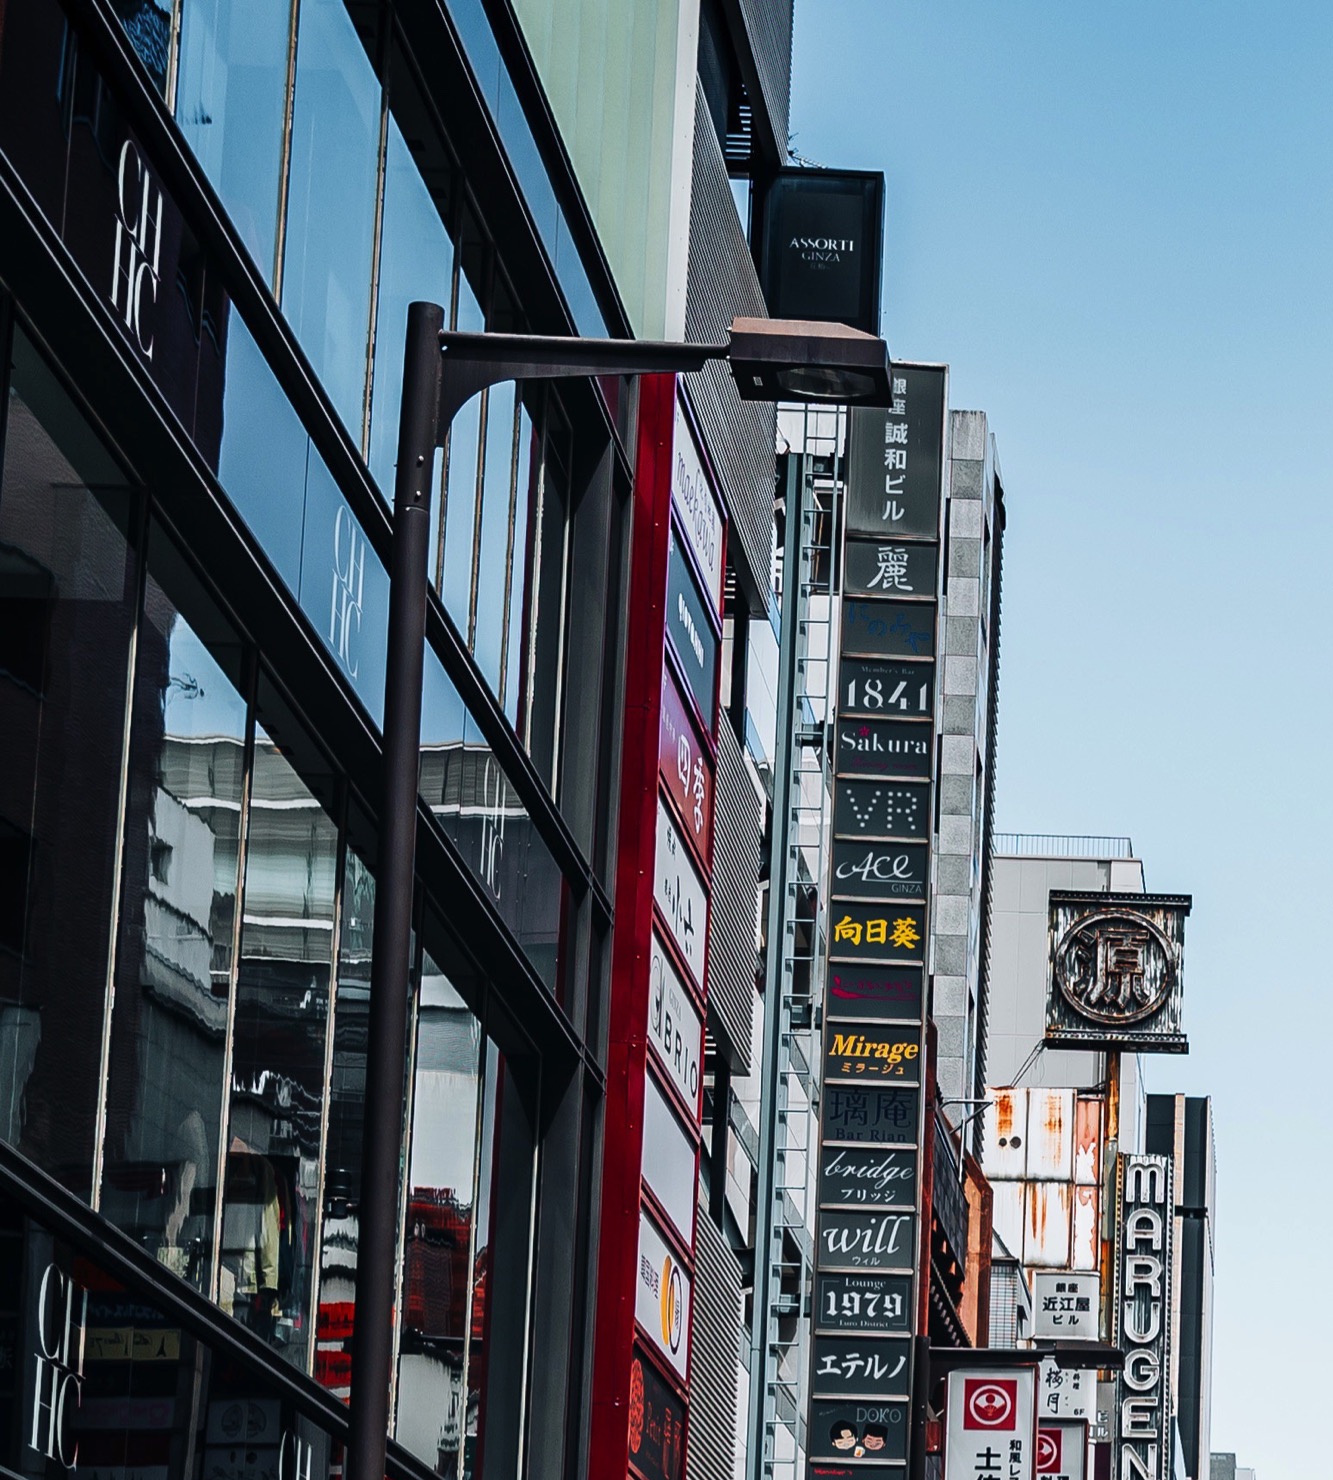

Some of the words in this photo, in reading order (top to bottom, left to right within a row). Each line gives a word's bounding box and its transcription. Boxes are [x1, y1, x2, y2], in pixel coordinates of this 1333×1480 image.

[789, 237, 855, 252] ASSORTI
[801, 251, 841, 263] GINZA
[867, 546, 914, 592] 麗
[847, 678, 928, 711] 1841
[841, 731, 928, 755] Sakura
[846, 788, 918, 831] VR
[891, 883, 923, 894] GINZA
[833, 915, 921, 949] 向日葵
[828, 1033, 919, 1065] Mirage
[841, 1062, 905, 1075] ミラージュ
[835, 1127, 865, 1142] Bar
[870, 1129, 907, 1142] Rian
[824, 1151, 915, 1191] bridge
[822, 1215, 911, 1255] will
[851, 1255, 881, 1266] ウィル
[844, 1276, 887, 1290] Lounge
[1055, 1281, 1079, 1295] 銀座
[825, 1289, 903, 1318] 1979
[1042, 1296, 1091, 1313] 近江屋
[1051, 1314, 1080, 1326] ビル
[816, 1352, 908, 1380] エテルノ
[855, 1406, 903, 1425] DOKO
